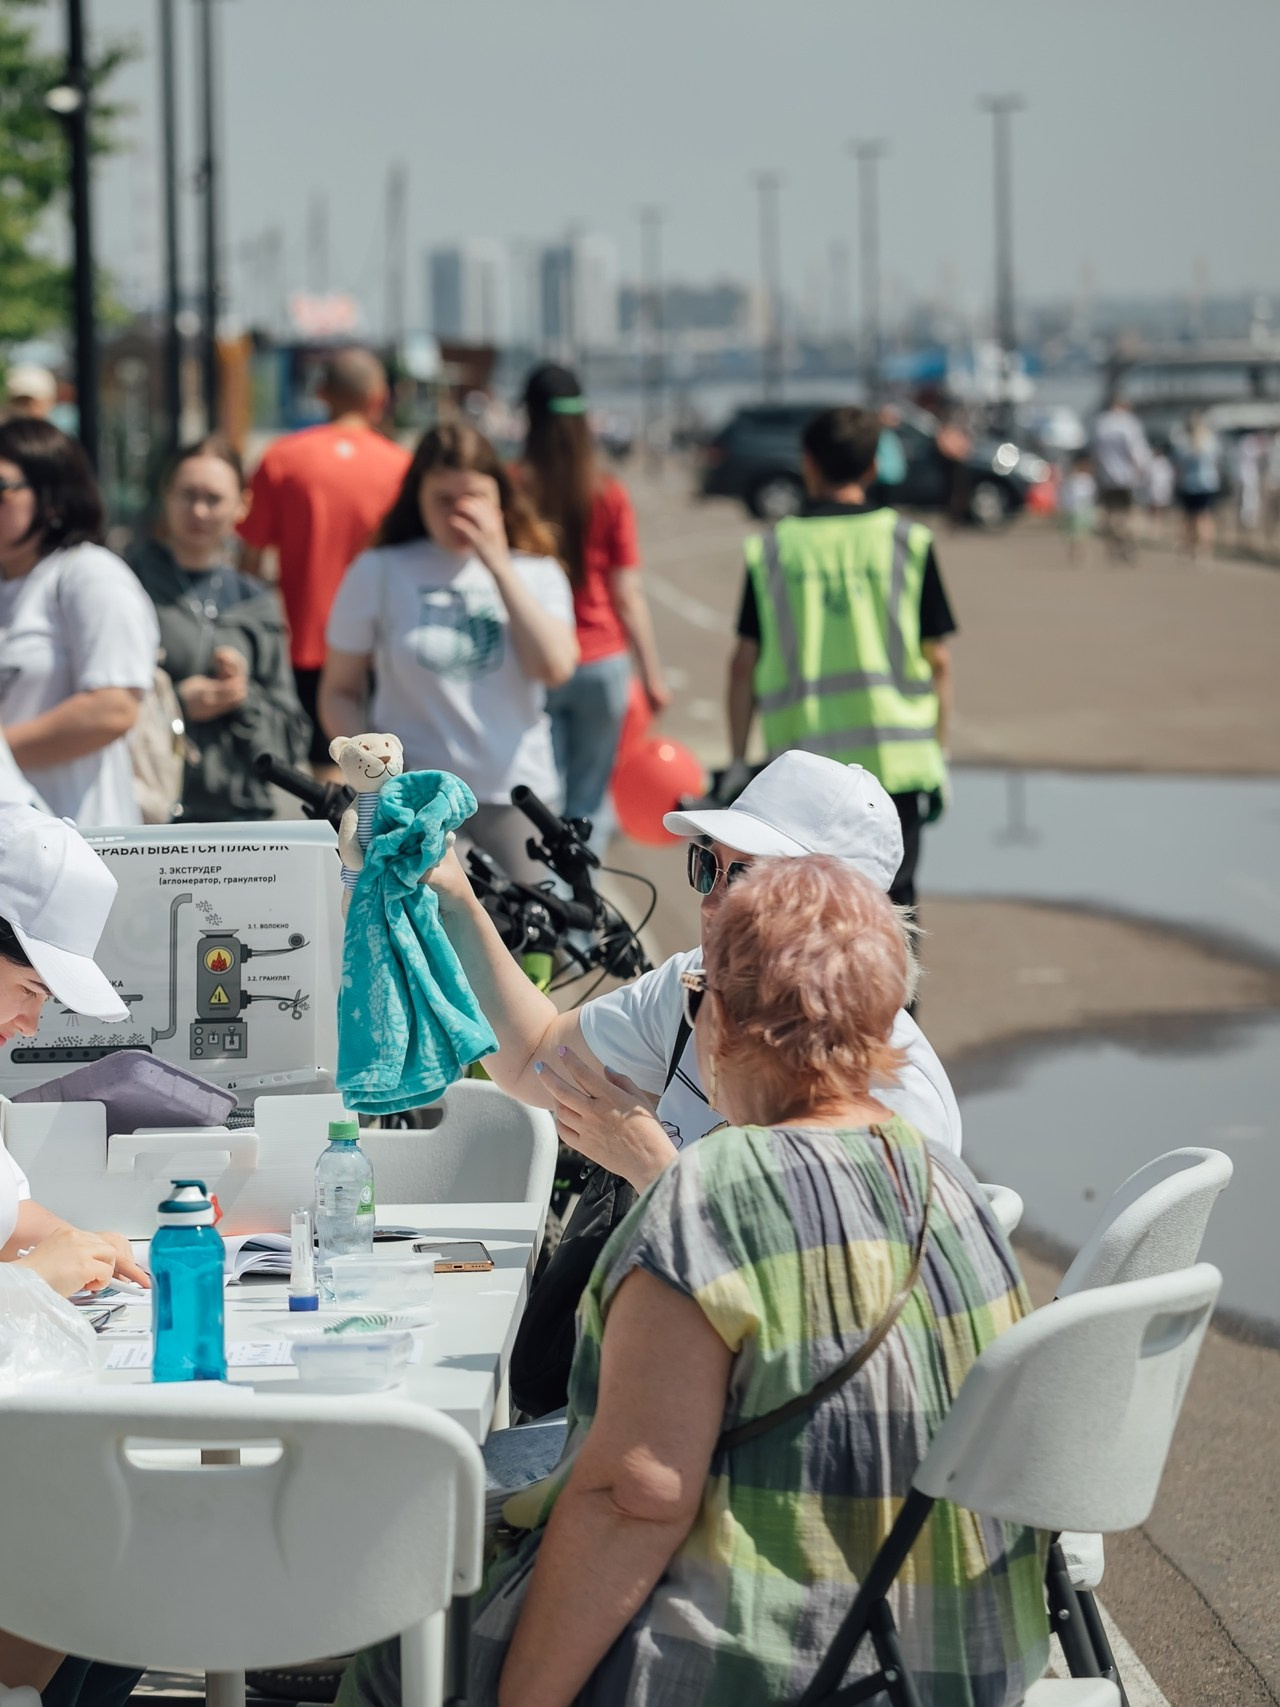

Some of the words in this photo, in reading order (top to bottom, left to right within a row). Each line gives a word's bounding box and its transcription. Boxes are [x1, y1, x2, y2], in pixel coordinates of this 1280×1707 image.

[159, 867, 167, 875] 3.
[169, 866, 222, 875] ЭКСТРУДЕР
[159, 877, 221, 886] (агломератор,
[223, 874, 276, 884] гранулятор)
